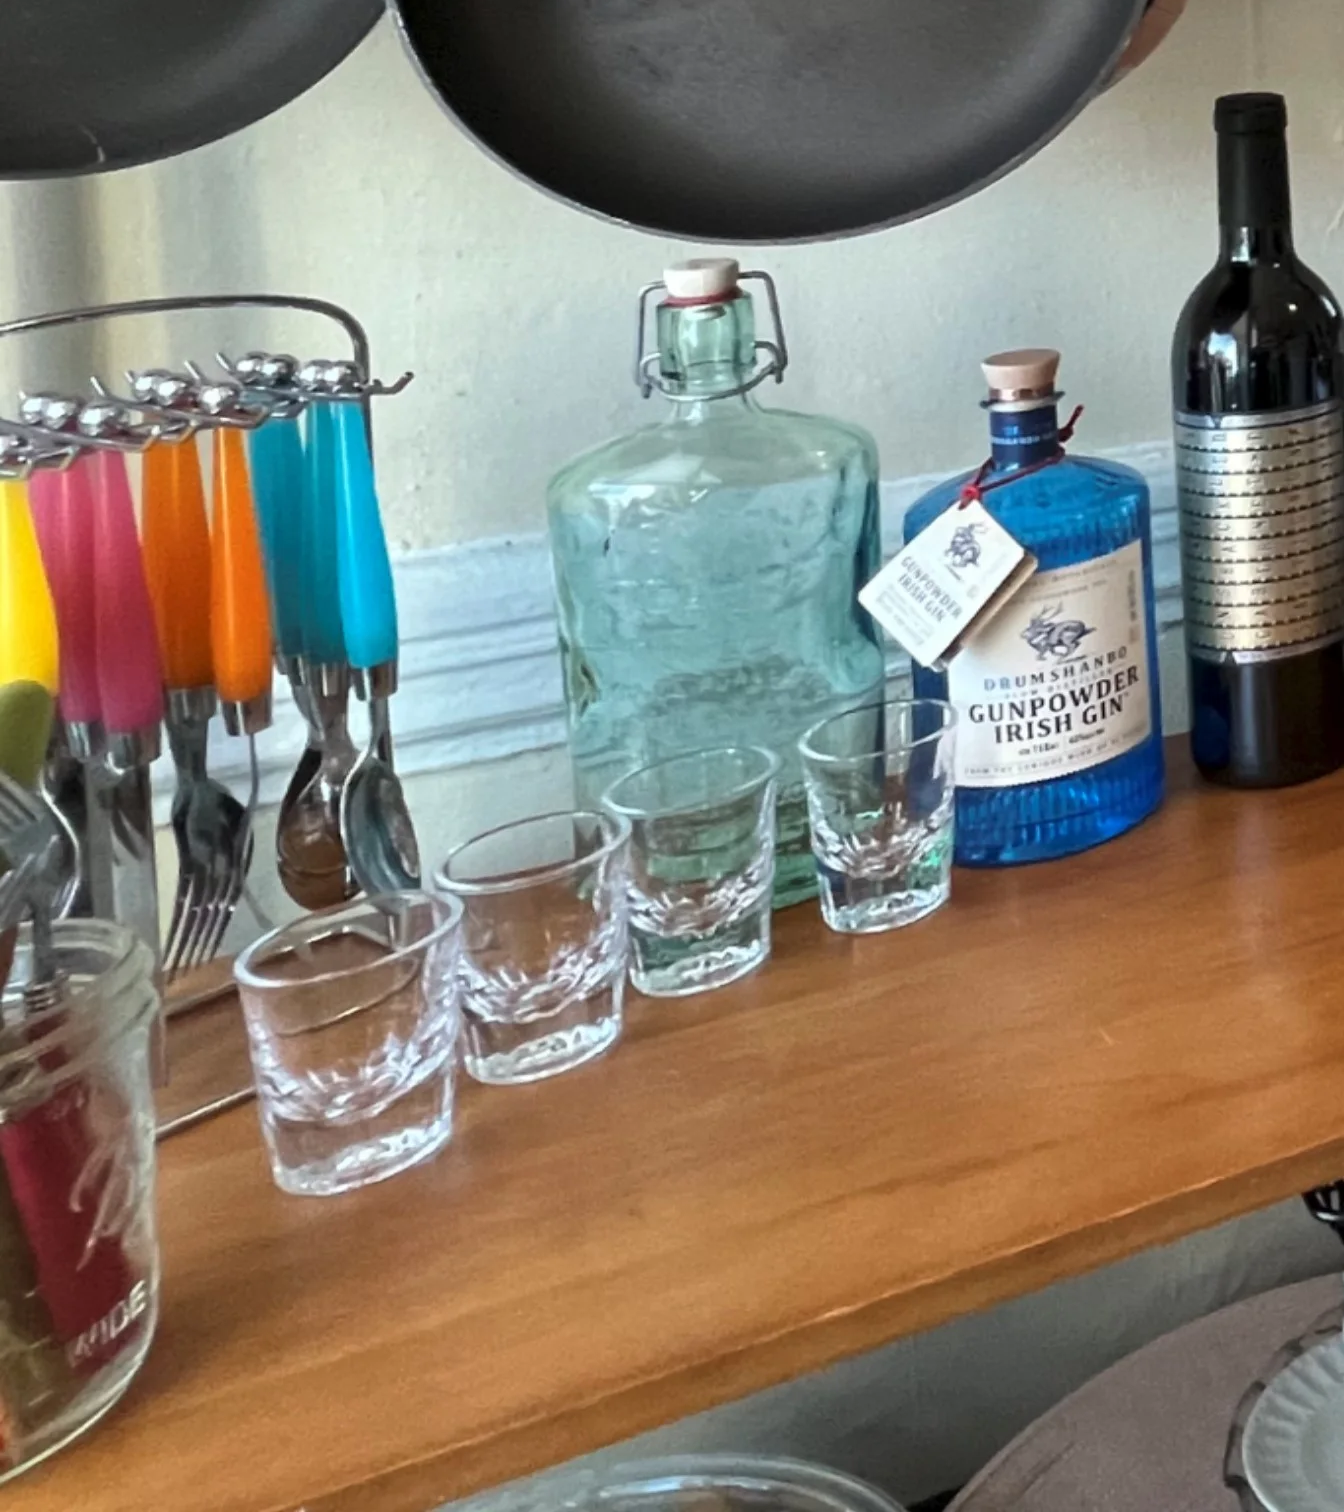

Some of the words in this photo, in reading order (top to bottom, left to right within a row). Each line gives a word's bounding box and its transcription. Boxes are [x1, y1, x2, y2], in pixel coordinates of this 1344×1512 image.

[900, 556, 963, 620] GUNPOWDER
[968, 665, 1140, 724] GUNPOWDER
[983, 646, 1128, 691] DRUMSHANBO
[994, 712, 1073, 744] IRISH
[1081, 694, 1124, 726] GIN
